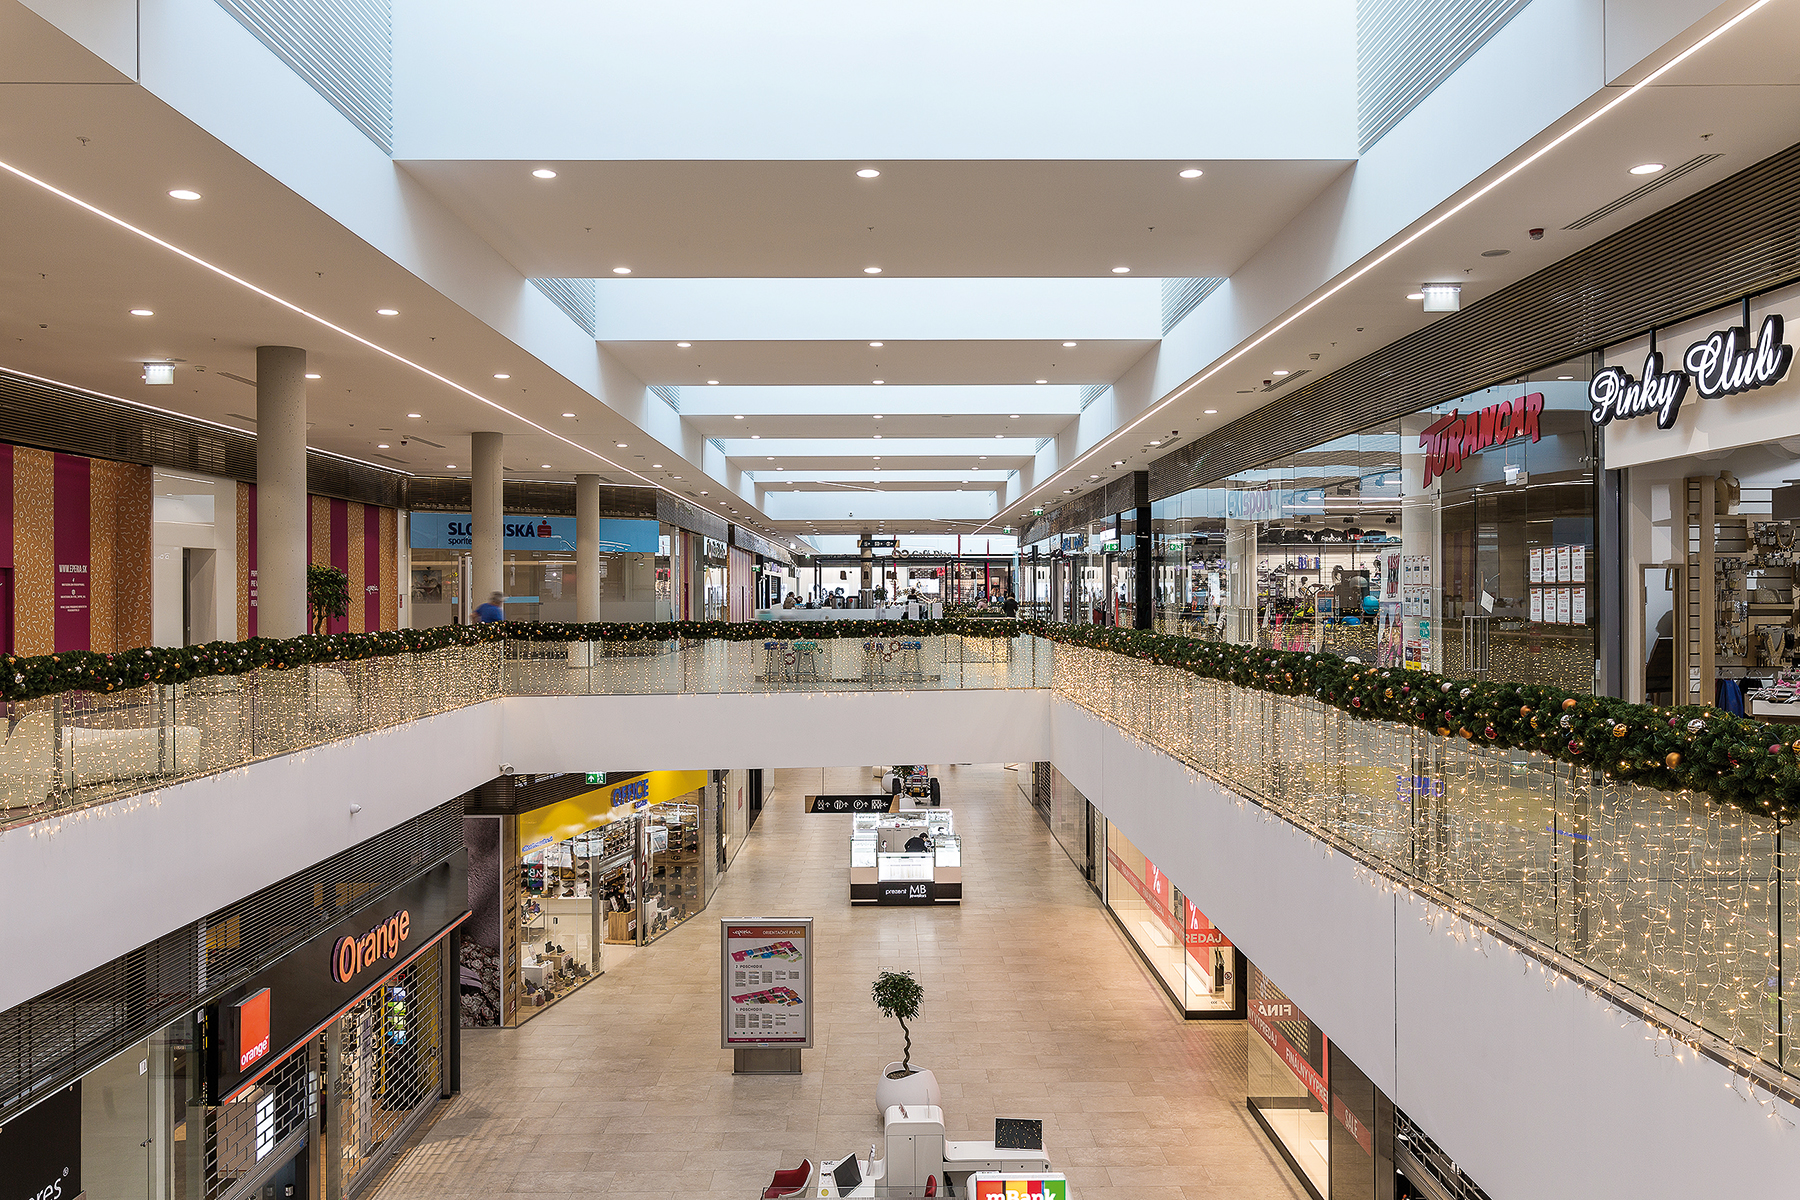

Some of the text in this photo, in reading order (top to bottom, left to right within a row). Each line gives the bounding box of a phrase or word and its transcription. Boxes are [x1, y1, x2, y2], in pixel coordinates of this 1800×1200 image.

[1589, 317, 1784, 426] Pinky Club
[1418, 391, 1545, 489] TURANCAR
[612, 778, 650, 808] OFFICE
[909, 884, 927, 894] MB
[337, 909, 411, 983] Orange
[240, 1038, 268, 1067] orange
[1344, 1108, 1359, 1139] SALE
